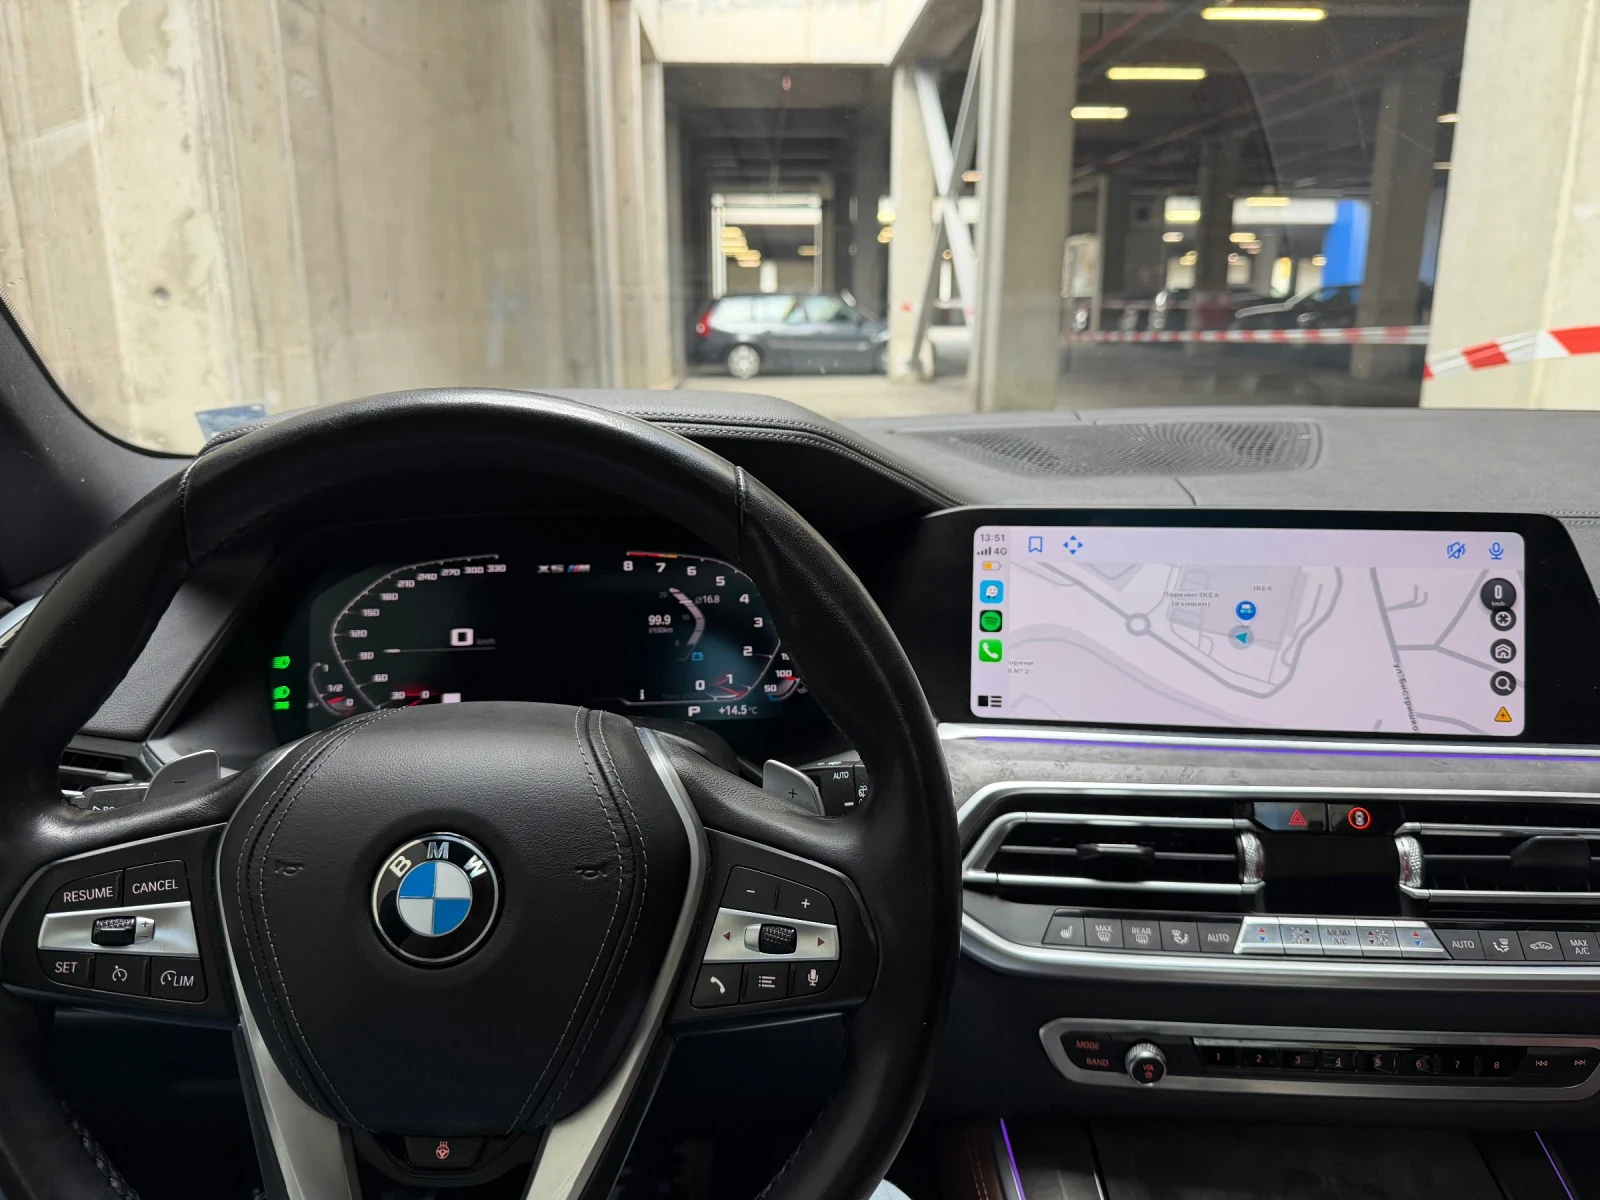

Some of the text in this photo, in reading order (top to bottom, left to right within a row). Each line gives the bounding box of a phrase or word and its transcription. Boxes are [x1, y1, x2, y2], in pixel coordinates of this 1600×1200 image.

[980, 534, 1005, 542] 13:51
[993, 547, 1007, 555] 4G
[464, 566, 484, 574] 300
[486, 564, 506, 573] 330
[623, 561, 633, 572] 8
[656, 562, 666, 573] 7
[686, 566, 696, 576] 6
[440, 568, 460, 576] 270
[396, 580, 415, 588] 210
[716, 576, 726, 586] 5
[380, 592, 398, 600] 180
[1494, 584, 1502, 600] 0
[740, 594, 750, 604] 4
[362, 608, 380, 616] 150
[648, 614, 672, 626] 99.9
[754, 617, 763, 628] 3
[349, 630, 368, 638] 120
[450, 628, 474, 646] 0
[743, 646, 753, 656] 2
[359, 652, 374, 660] 90
[373, 674, 388, 682] 60
[775, 670, 792, 678] 100
[726, 674, 733, 684] 1
[326, 684, 344, 692] 1/2
[695, 680, 706, 691] 0
[764, 684, 778, 692] 50
[391, 691, 406, 700] 30
[421, 690, 430, 698] 0
[688, 706, 700, 717] P
[833, 771, 849, 780] AUTO
[389, 842, 488, 878] BMW
[132, 879, 178, 895] CANCEL
[63, 886, 114, 903] RESUME
[1095, 924, 1112, 933] MAX
[1131, 926, 1152, 936] REAR
[1207, 933, 1230, 942] AUTO
[1452, 940, 1475, 949] AUTO
[1576, 946, 1590, 954] A/C
[54, 961, 78, 974] SET
[173, 975, 194, 987] LIM
[1076, 1040, 1101, 1050] MODE
[1086, 1057, 1110, 1066] BAND
[1256, 1054, 1262, 1062] 2
[1335, 1058, 1342, 1066] 4
[1416, 1060, 1422, 1068] 6
[1455, 1060, 1460, 1068] 7
[1494, 1061, 1500, 1069] 8
